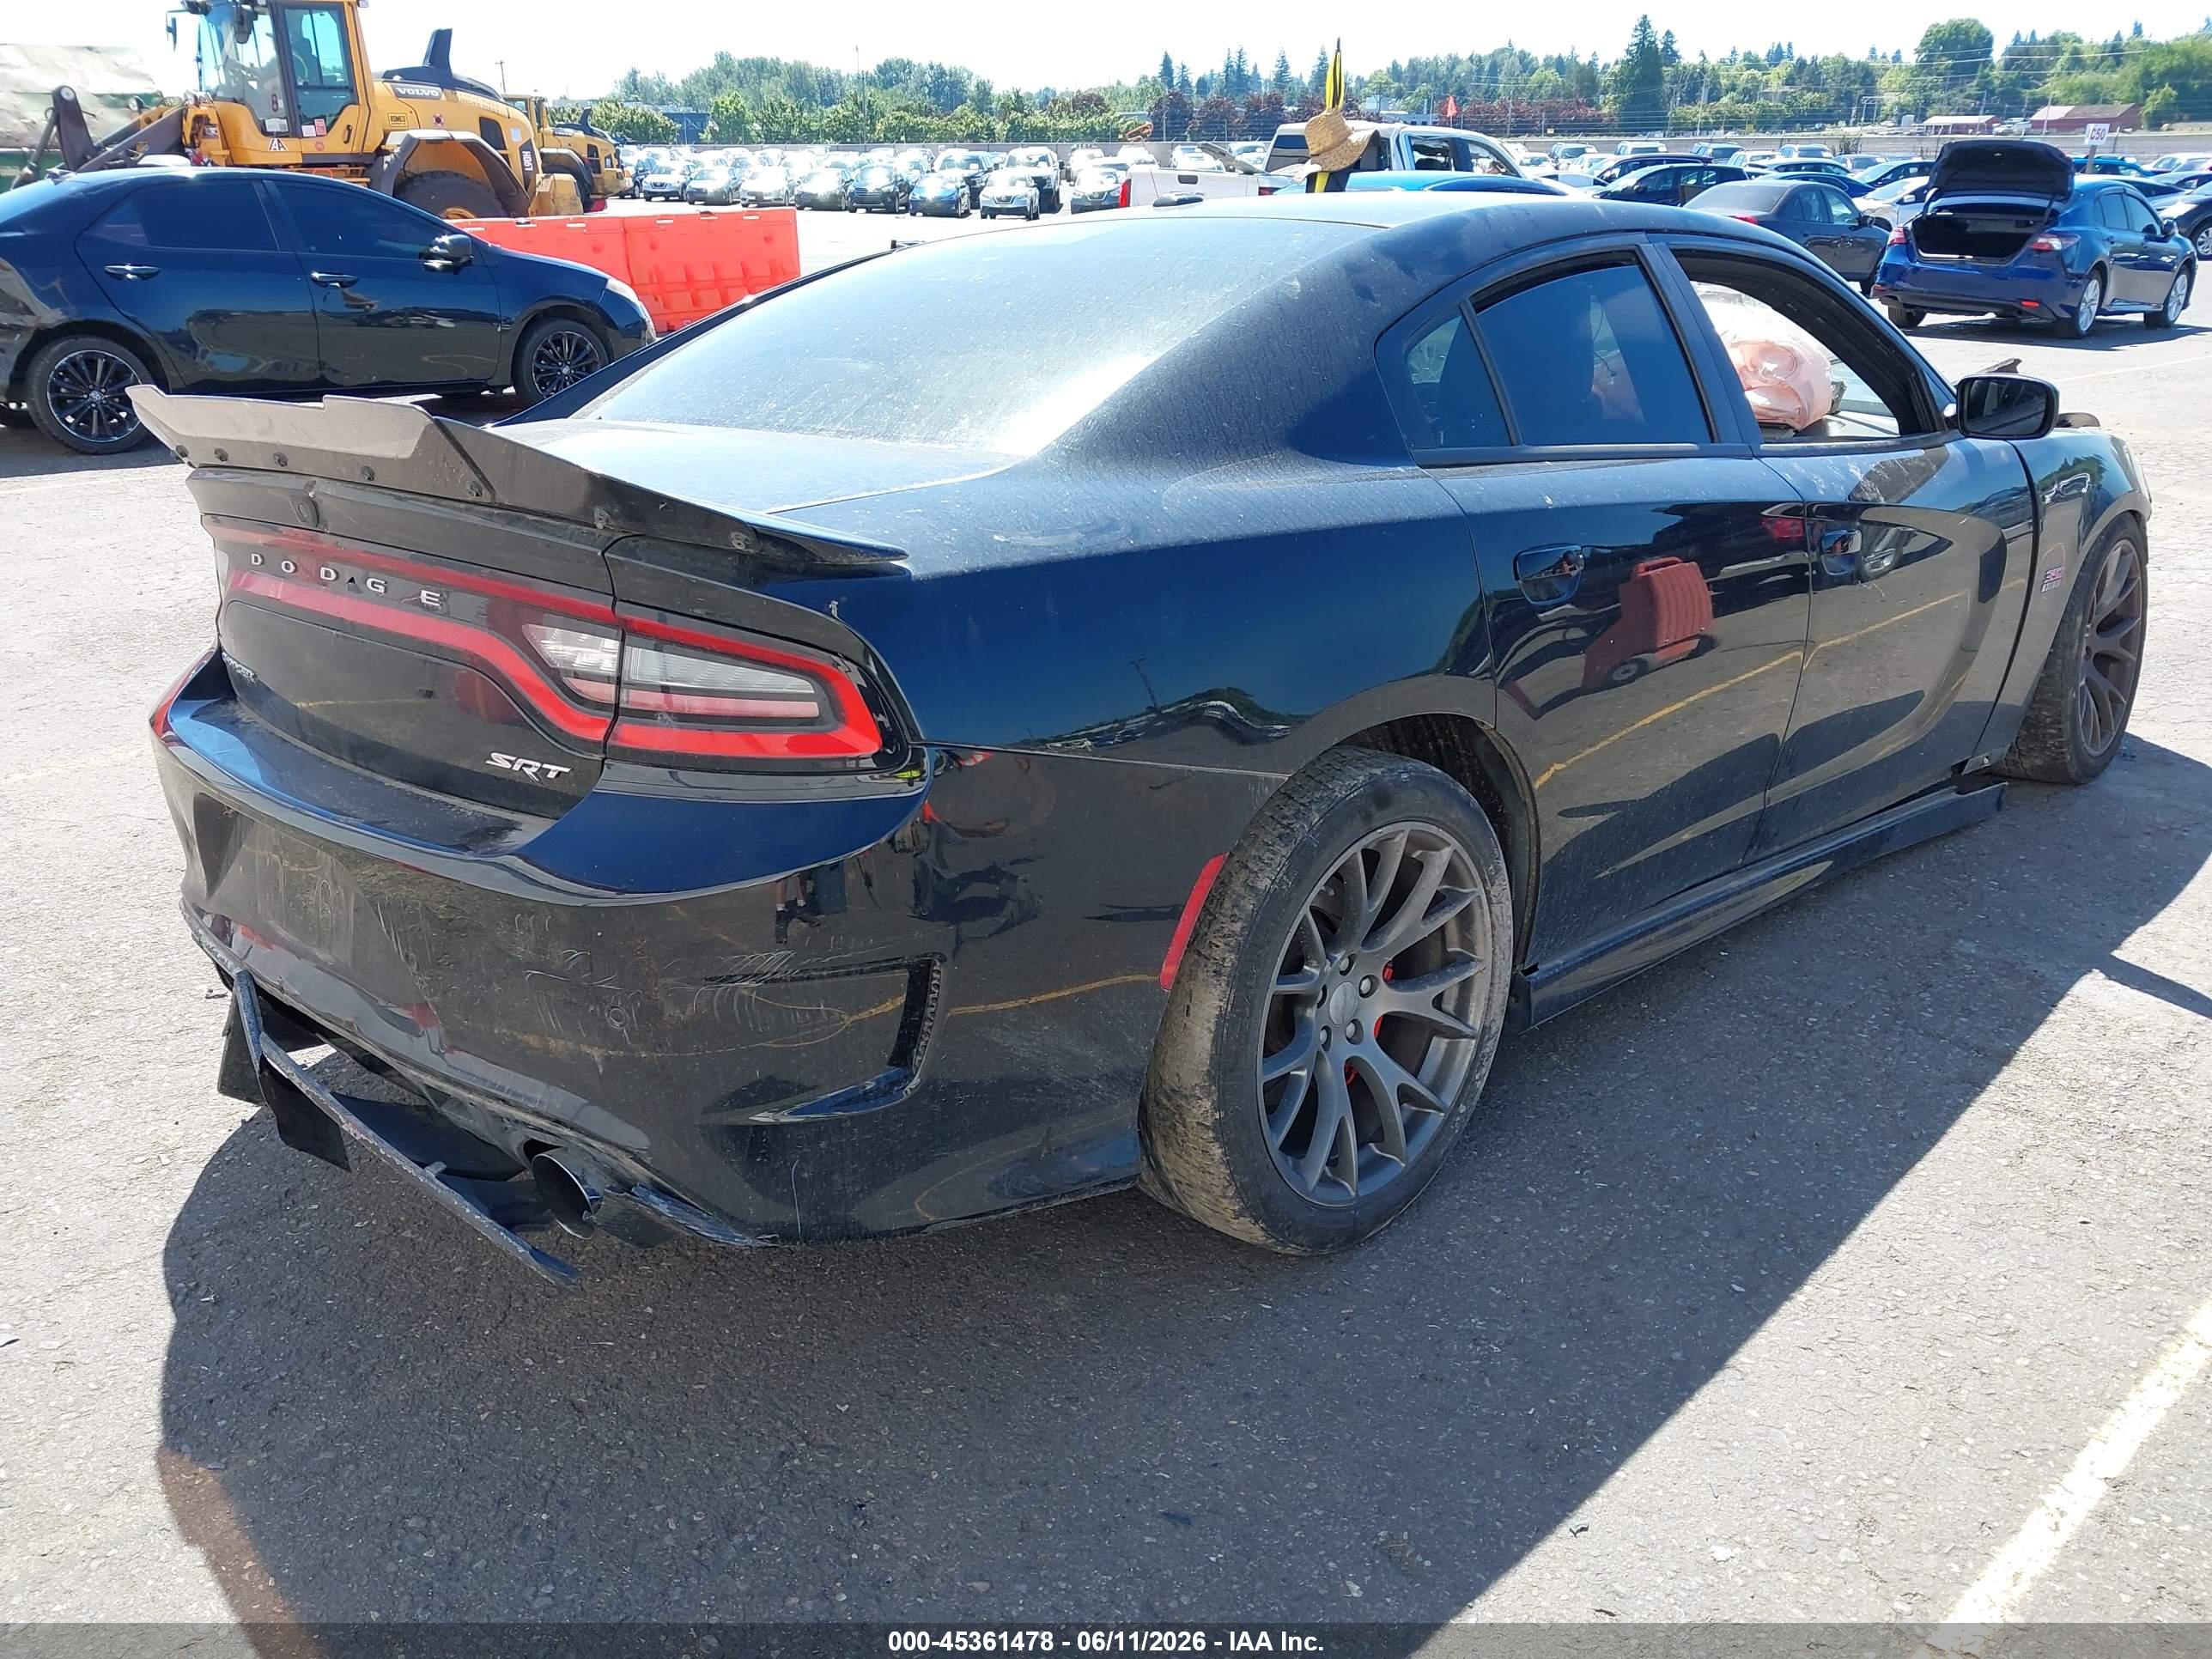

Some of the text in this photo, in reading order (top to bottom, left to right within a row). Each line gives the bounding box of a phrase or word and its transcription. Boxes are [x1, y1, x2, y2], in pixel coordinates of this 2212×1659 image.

[395, 87, 440, 97] VOLVO
[2090, 128, 2106, 141] C50
[521, 150, 533, 171] L90H
[251, 552, 441, 607] DODGE
[485, 752, 573, 781] SRT
